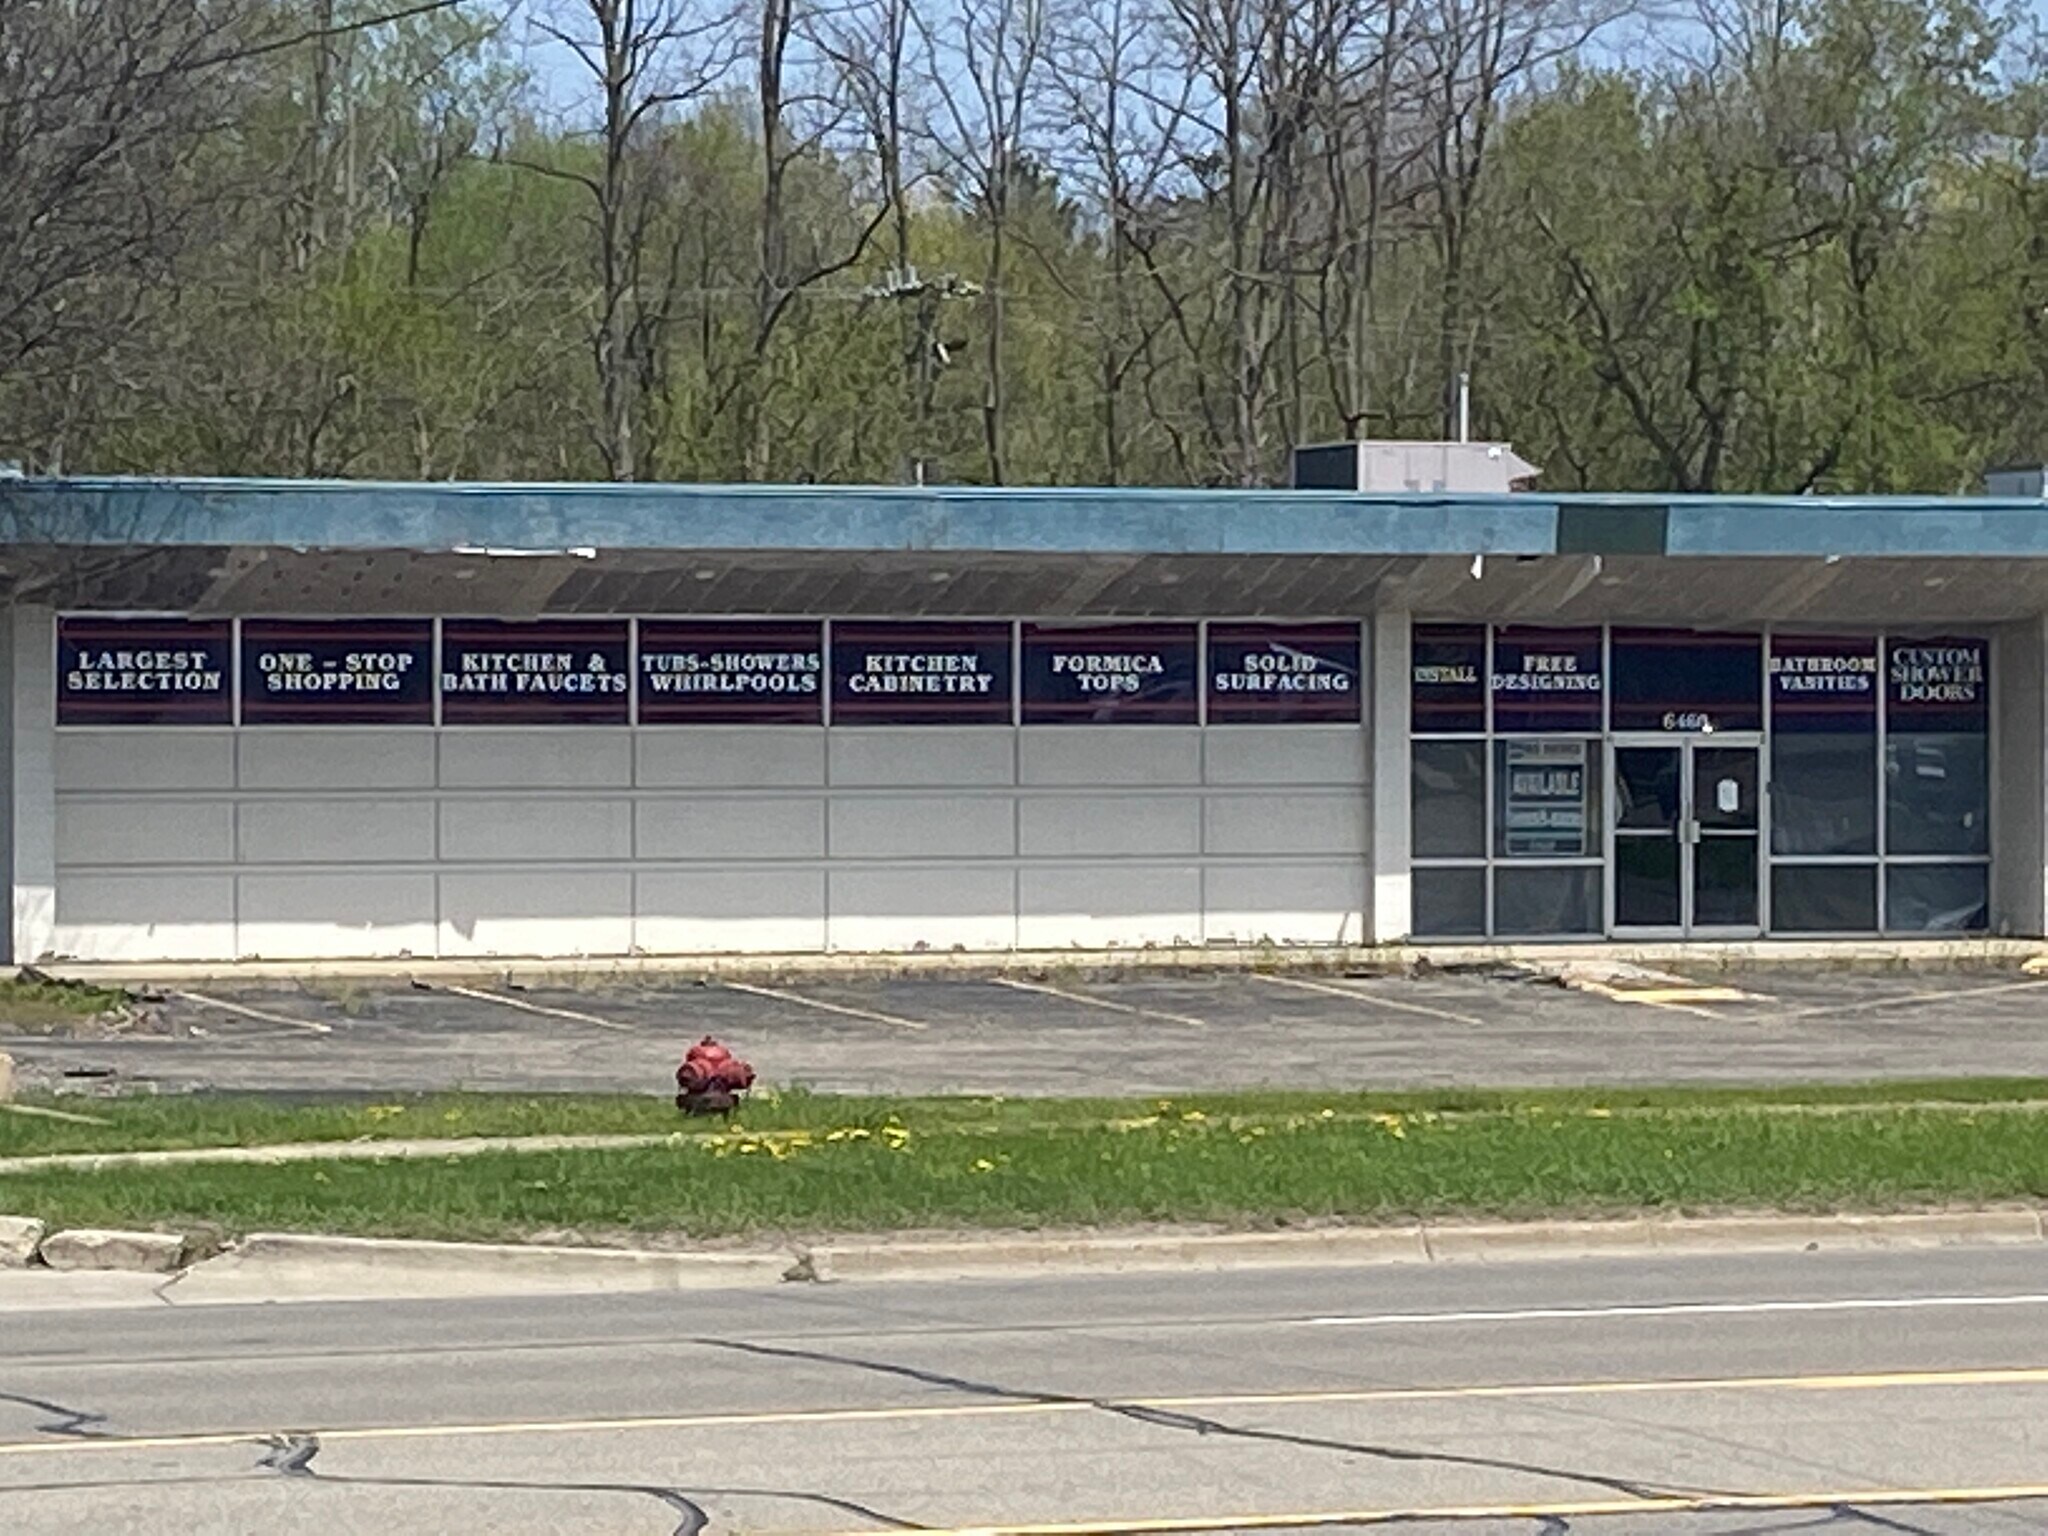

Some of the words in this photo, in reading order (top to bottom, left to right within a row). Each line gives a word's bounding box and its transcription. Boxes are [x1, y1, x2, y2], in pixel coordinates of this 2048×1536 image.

[79, 652, 208, 670] LARGEST
[259, 653, 313, 671] ONE
[345, 653, 413, 671] STOP
[462, 653, 572, 671] KITCHEN
[587, 653, 605, 671] &
[866, 655, 978, 672] KITCHEN
[1053, 655, 1164, 672] FORMICA
[1244, 655, 1317, 672] SOLID
[1523, 655, 1577, 672] FREE
[68, 671, 221, 690] SELECTION
[267, 673, 400, 691] SHOPPING
[442, 673, 507, 691] BATH
[516, 673, 627, 691] FAUCETS
[650, 673, 817, 692] WHIRLPOOLS
[849, 674, 993, 692] CABINETRY
[1080, 674, 1140, 691] TOPS
[1216, 673, 1350, 690] SURFACING
[1491, 673, 1600, 690] DESIGNING
